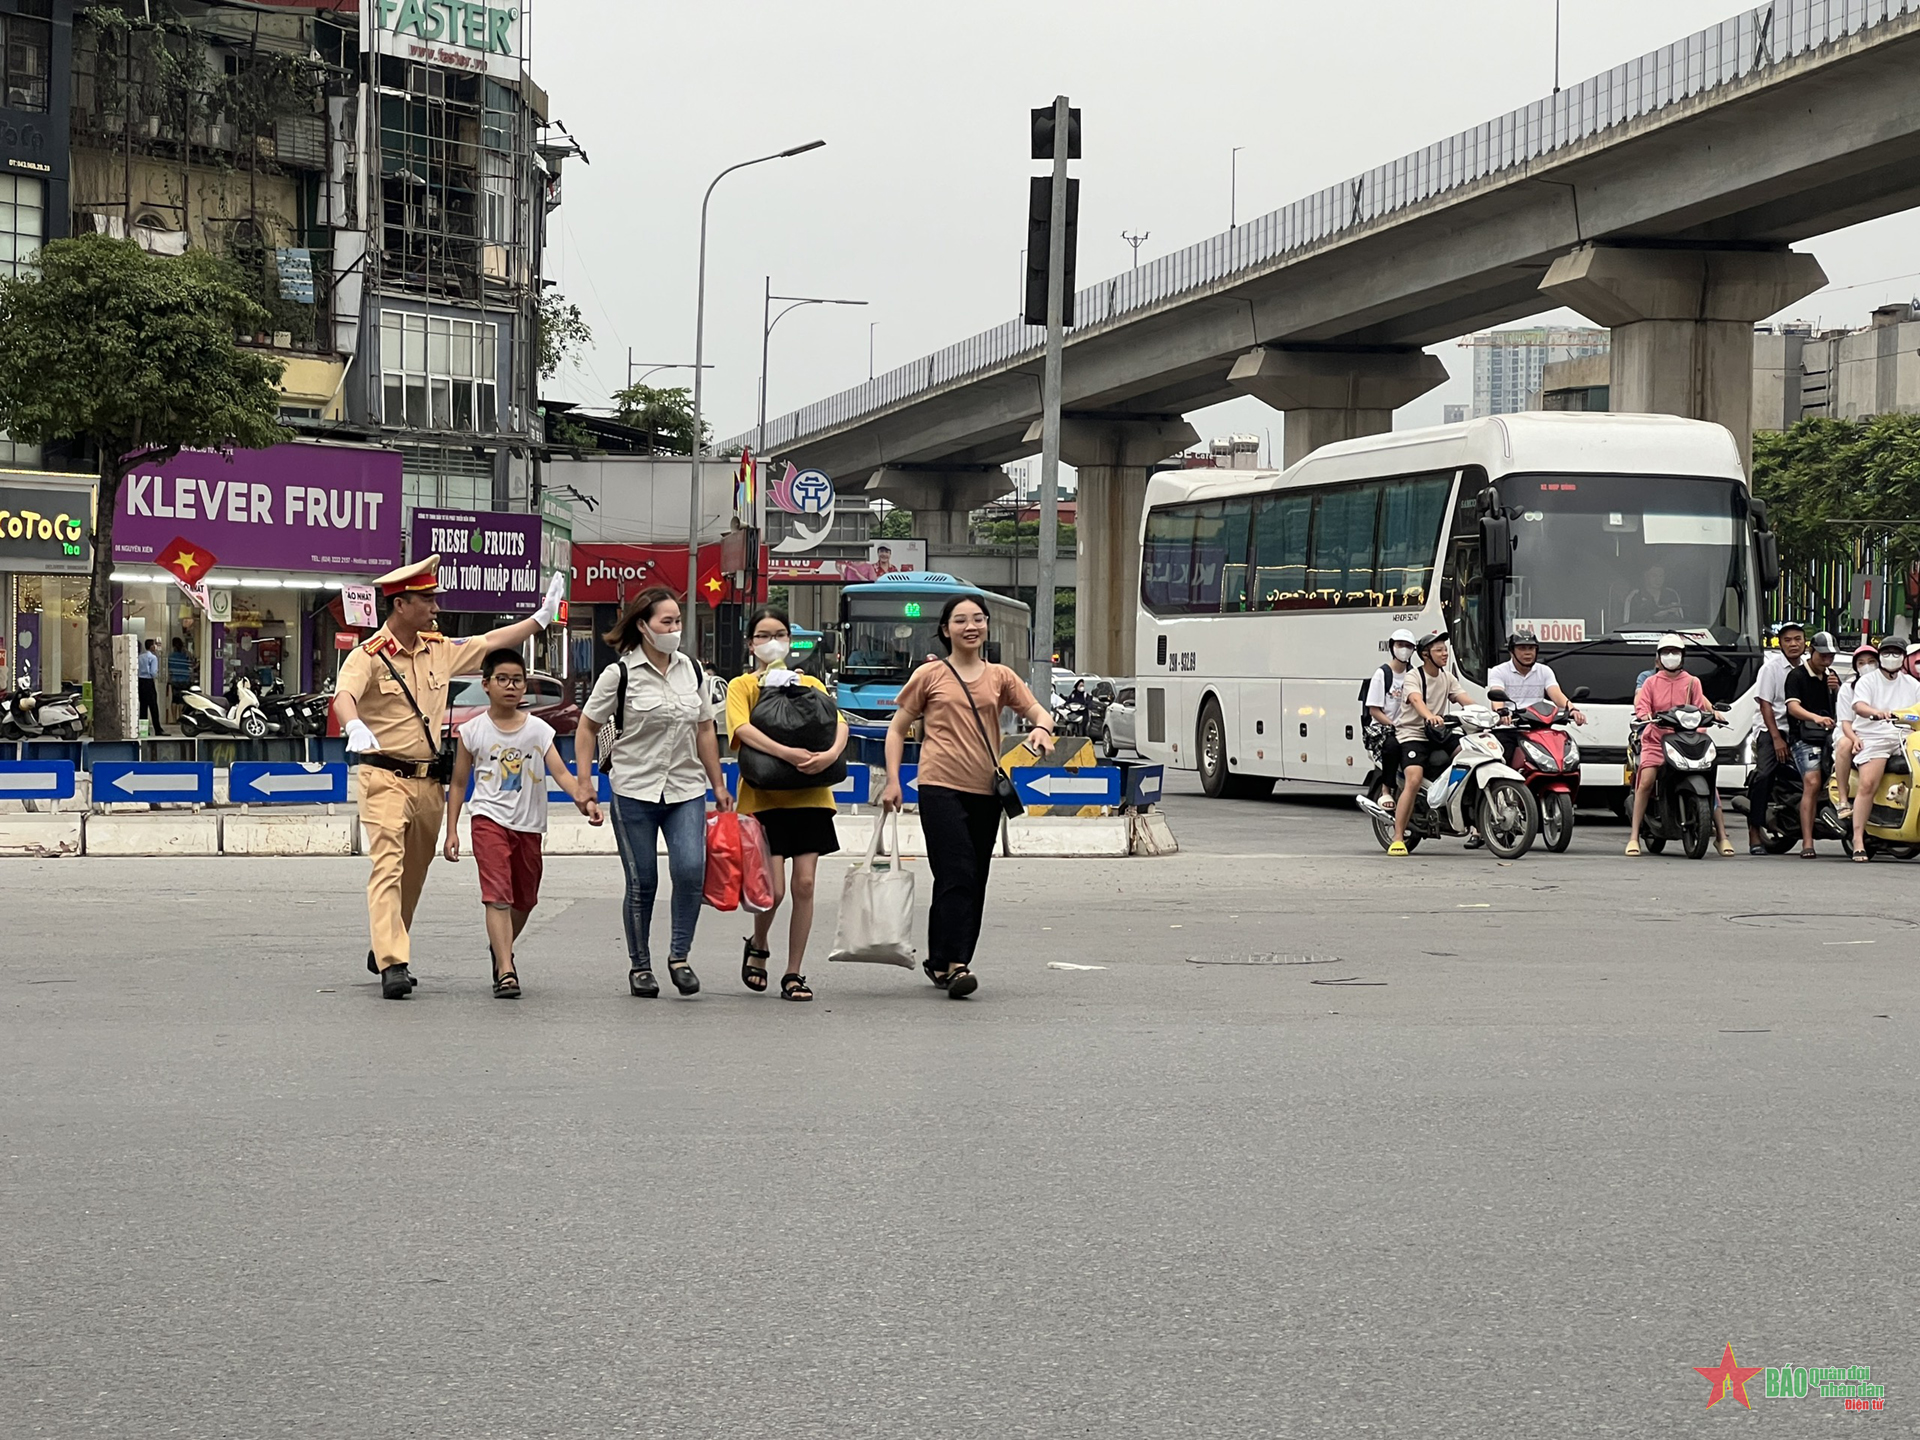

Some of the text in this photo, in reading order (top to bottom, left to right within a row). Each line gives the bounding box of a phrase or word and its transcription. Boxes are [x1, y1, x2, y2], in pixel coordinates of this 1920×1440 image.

[127, 473, 384, 531] KLEVER FRUIT
[63, 542, 80, 555] Tea
[431, 527, 469, 554] FRESH
[484, 530, 525, 556] FRUITS
[438, 558, 537, 597] QUẢ TƯƠI NHẬP KHẨU
[905, 603, 920, 617] 02
[1540, 620, 1583, 642] ĐÔNG
